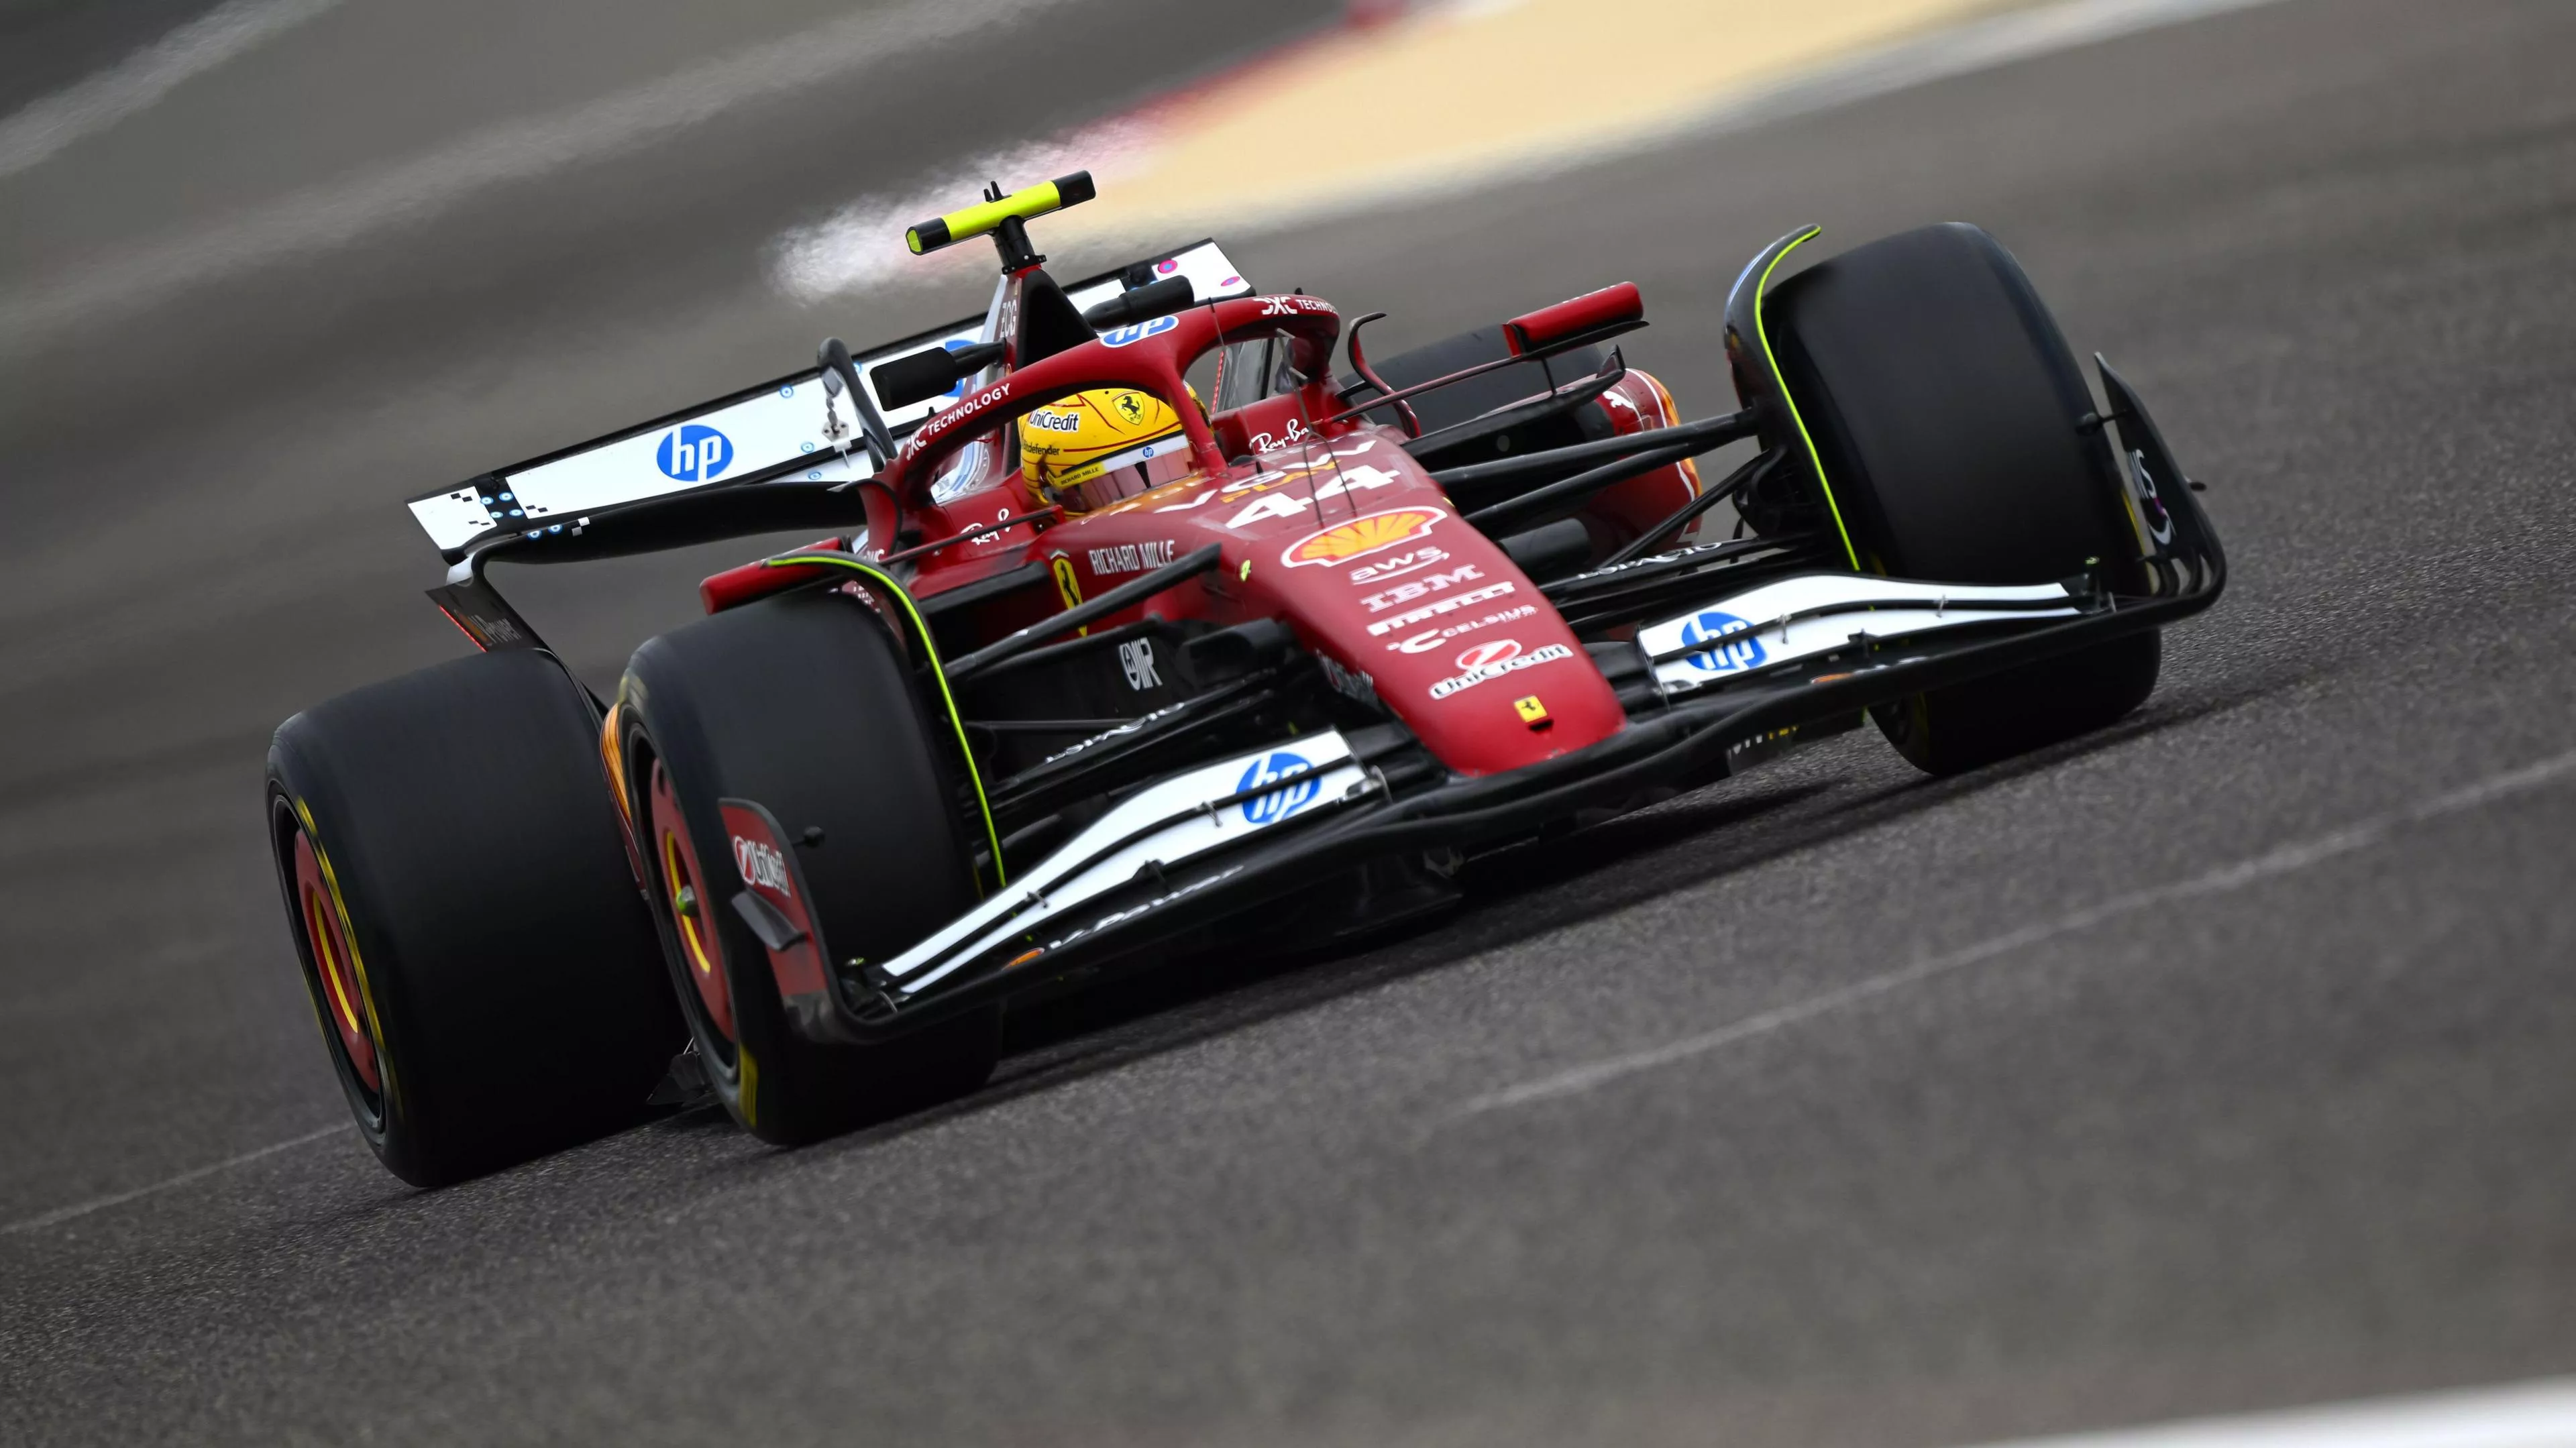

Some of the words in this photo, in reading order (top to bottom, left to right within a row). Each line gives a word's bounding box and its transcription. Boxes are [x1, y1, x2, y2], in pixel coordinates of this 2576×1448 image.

[1295, 299, 1338, 313] TECHNO
[928, 383, 1011, 436] TECHNOLOGY
[1030, 410, 1079, 431] UniCredit
[670, 425, 723, 483] hp
[1248, 418, 1310, 453] Ray-Ba
[1224, 464, 1401, 529] 44
[1088, 544, 1140, 576] RICHARD
[1139, 539, 1175, 569] MILLE
[1350, 546, 1443, 581] aws
[1359, 563, 1485, 613] IBM
[1688, 613, 1756, 671] hp
[1433, 645, 1567, 696] UniCredit
[1250, 753, 1313, 824] hp
